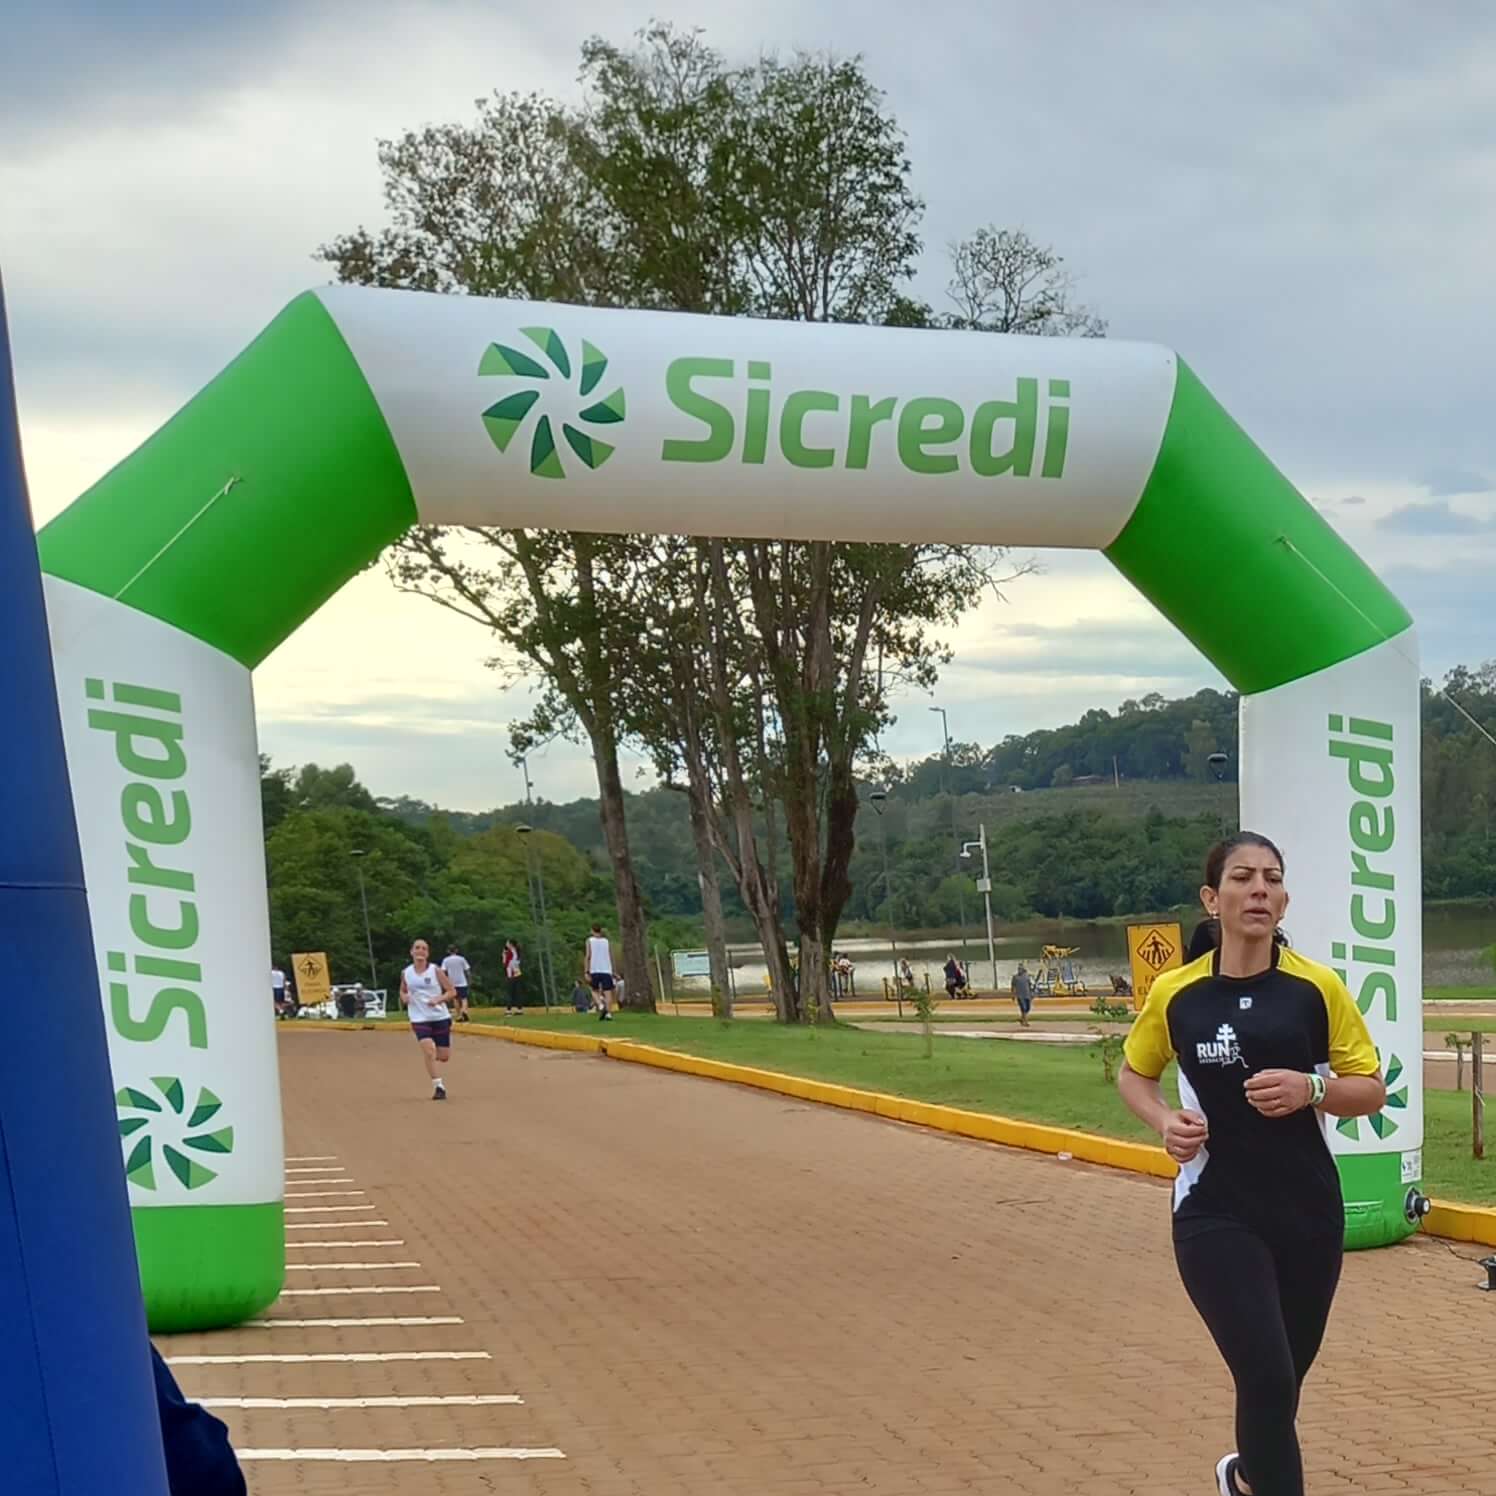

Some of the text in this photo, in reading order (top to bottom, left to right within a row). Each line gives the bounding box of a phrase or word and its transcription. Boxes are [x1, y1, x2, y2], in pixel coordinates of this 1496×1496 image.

[661, 356, 1071, 479] Sicredi
[85, 677, 208, 1050] Sicredi
[1328, 713, 1397, 1022] Sicredi
[1196, 1041, 1230, 1058] RUN
